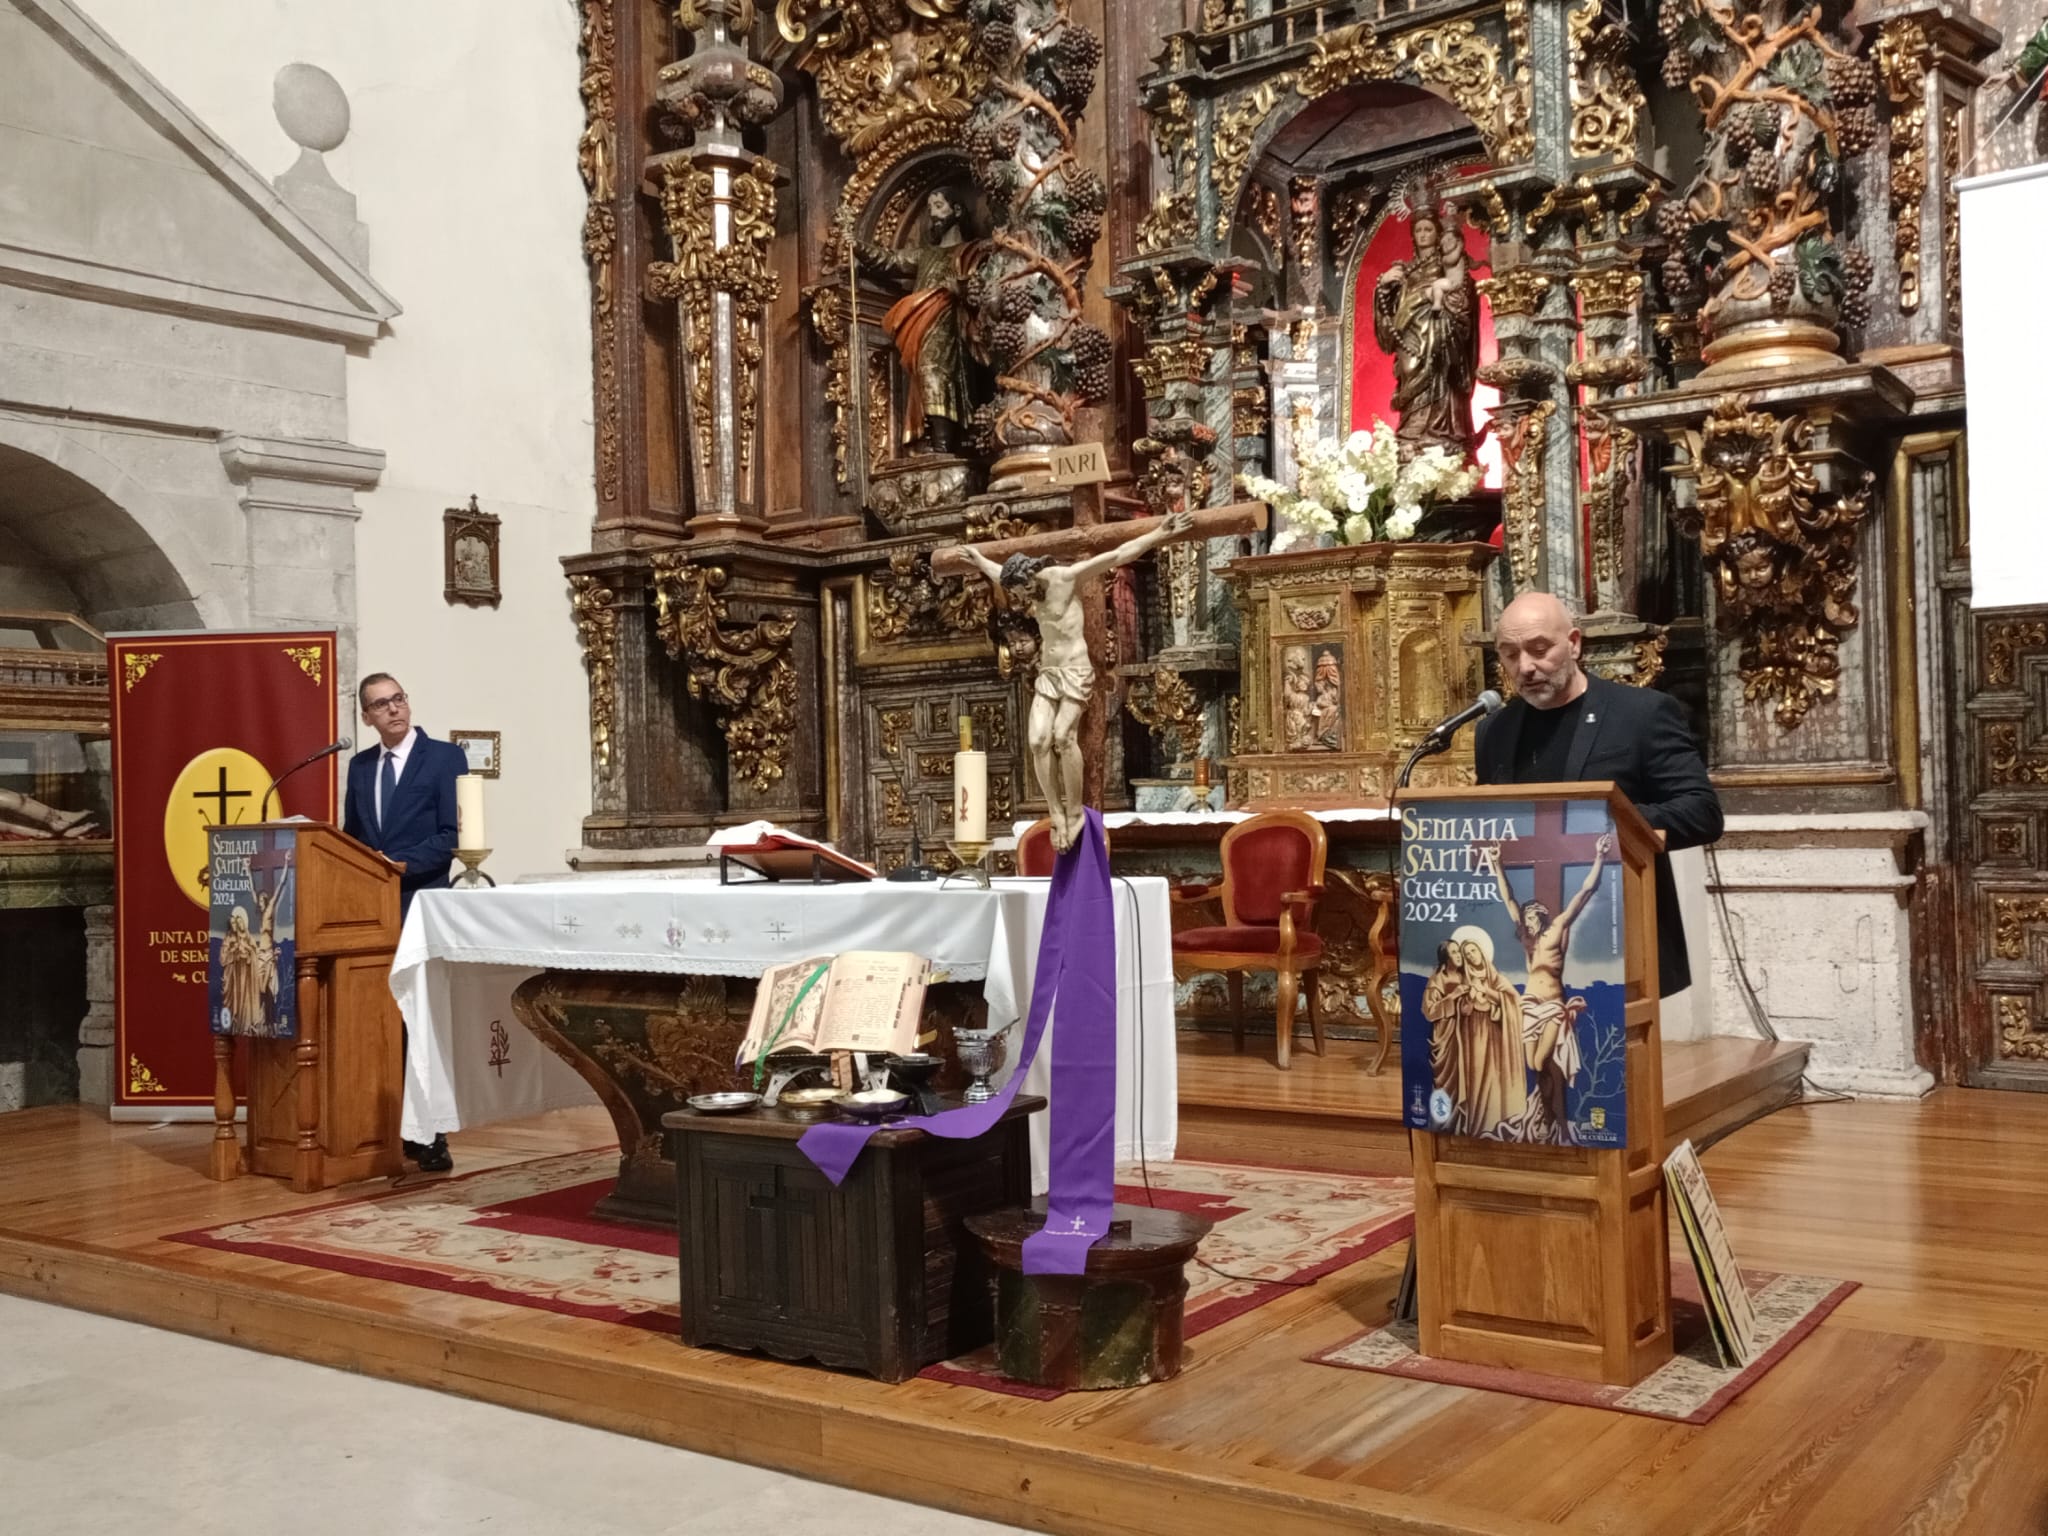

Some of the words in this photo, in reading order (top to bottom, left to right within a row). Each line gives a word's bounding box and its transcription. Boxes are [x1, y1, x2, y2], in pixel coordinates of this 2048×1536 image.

[1057, 452, 1097, 476] INRI
[1401, 807, 1519, 842] SEMANA
[213, 834, 258, 855] SEMANA
[213, 857, 251, 877] SANTA
[1403, 844, 1499, 877] SANTA
[212, 893, 235, 905] 2024
[1403, 877, 1503, 903] CUÉLLAR
[1404, 902, 1458, 922] 2024
[149, 931, 194, 947] JUNTA
[197, 930, 210, 944] D
[160, 950, 179, 963] DE
